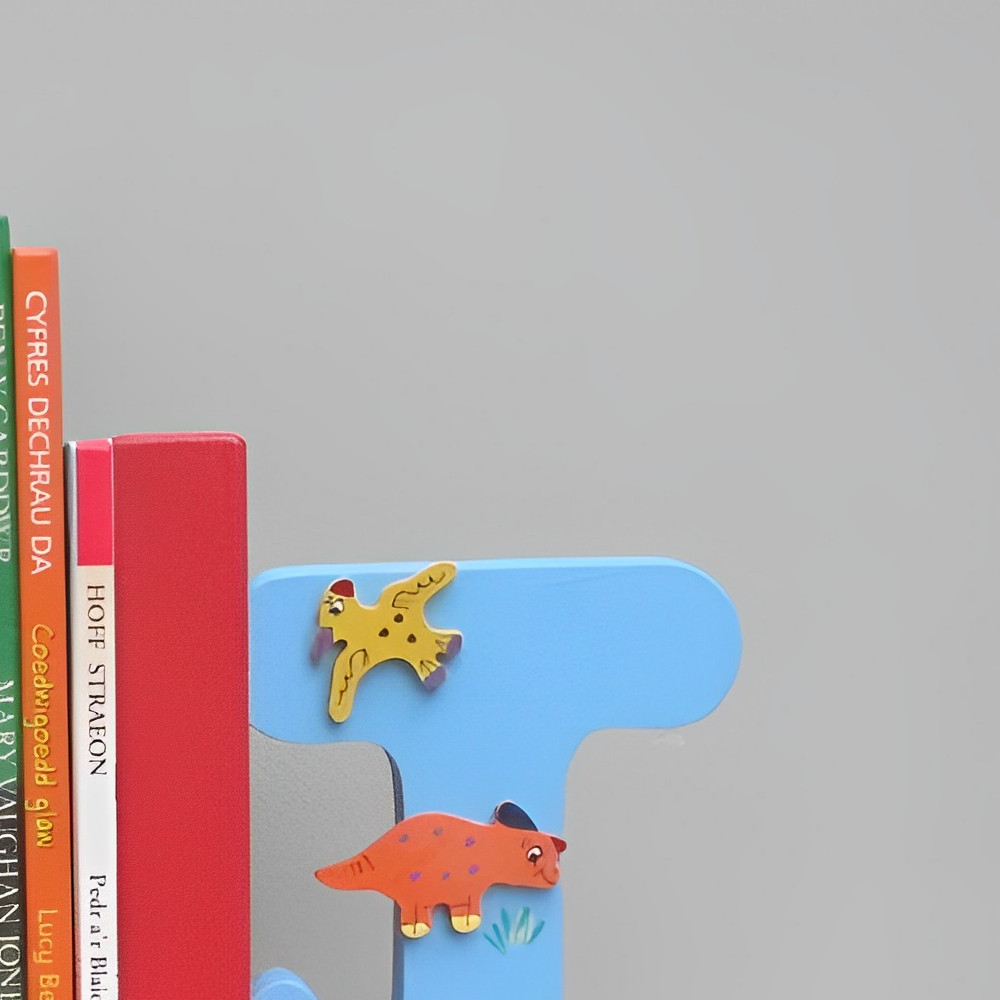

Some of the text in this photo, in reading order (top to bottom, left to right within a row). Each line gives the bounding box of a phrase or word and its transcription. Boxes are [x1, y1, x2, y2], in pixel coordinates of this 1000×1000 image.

[25, 291, 52, 575] CYFRES DECHRAU DA
[87, 585, 108, 776] HOFF STRAEON
[33, 909, 59, 965] Lucy
[88, 874, 107, 920] Pedr
